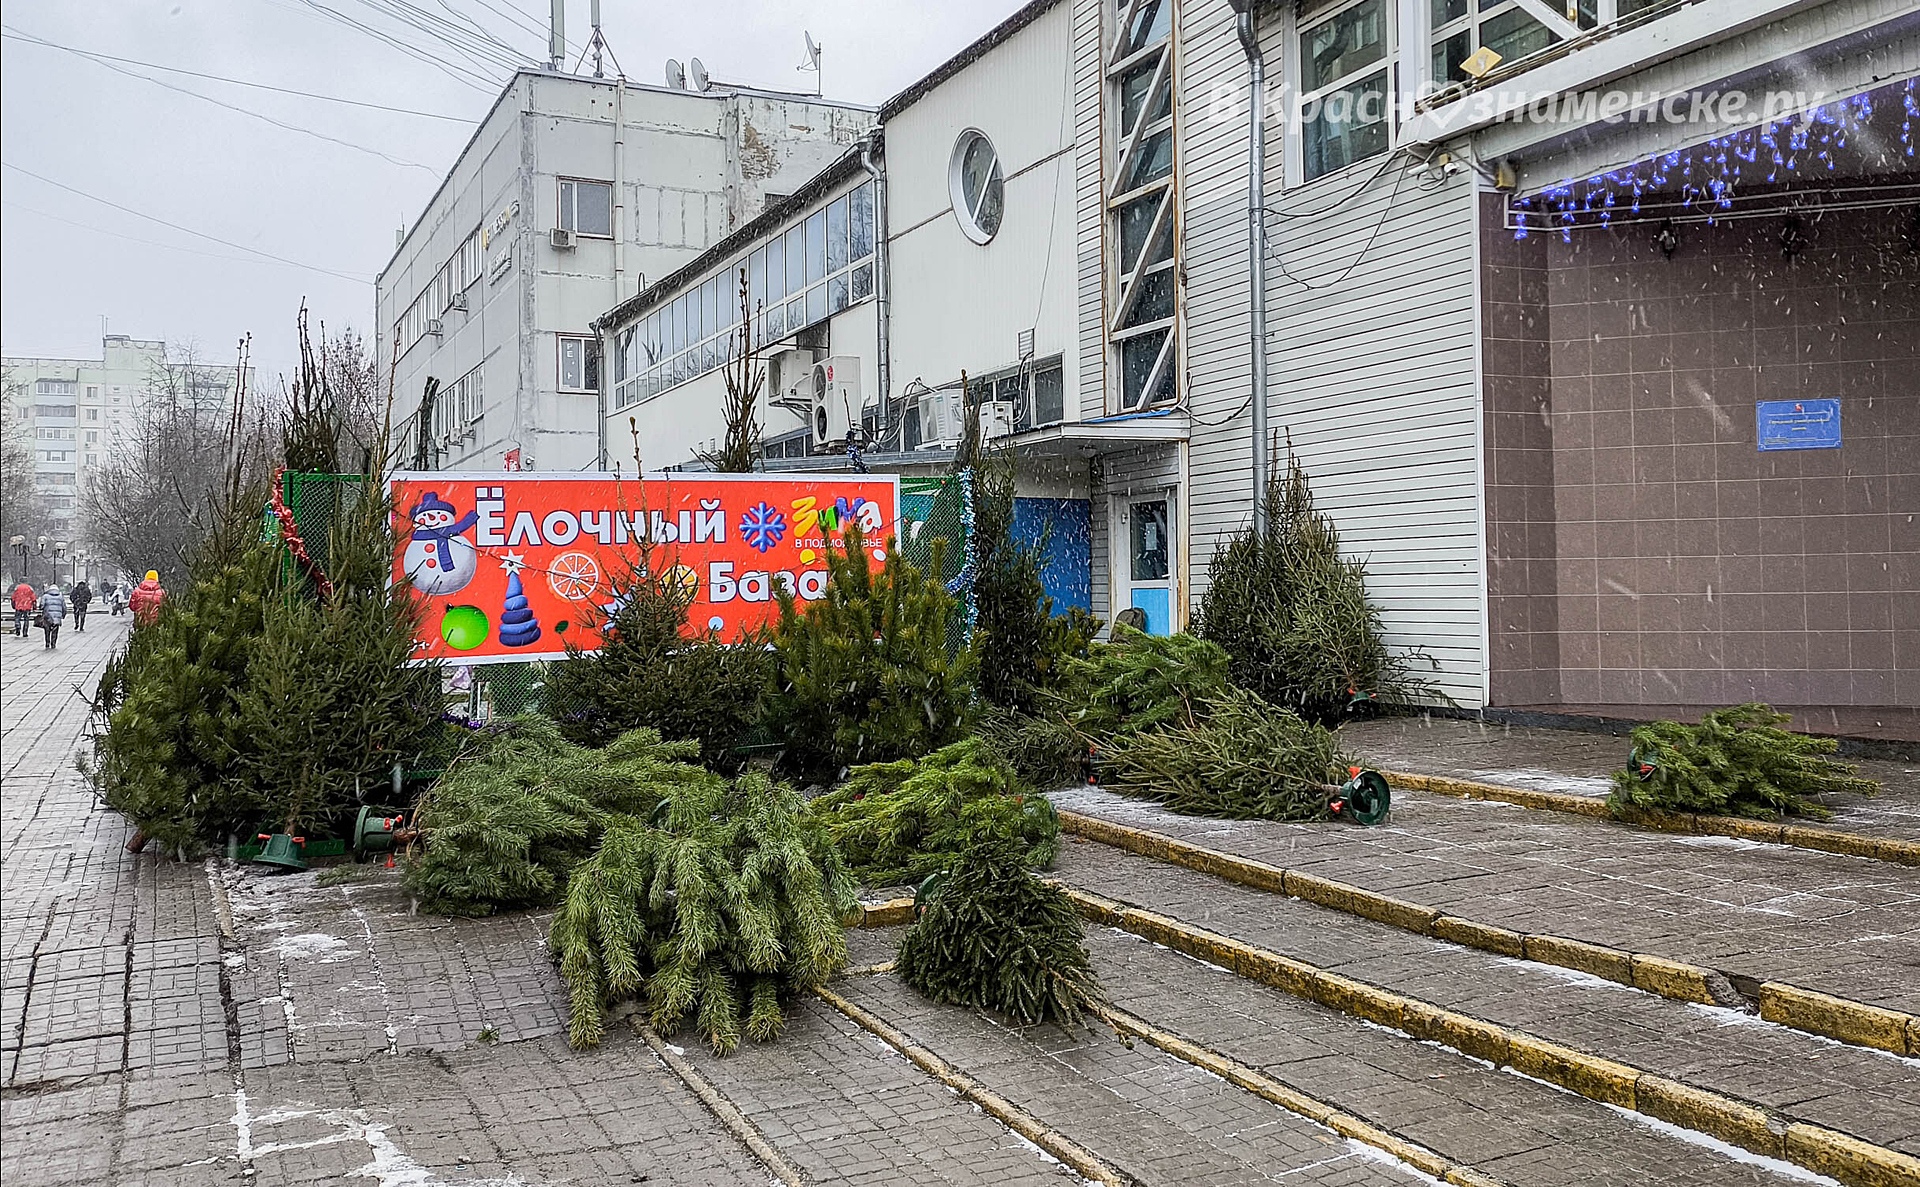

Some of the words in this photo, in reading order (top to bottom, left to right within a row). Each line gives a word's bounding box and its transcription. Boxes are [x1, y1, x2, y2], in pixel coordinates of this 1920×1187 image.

[475, 486, 726, 547] Ёлочный
[795, 538, 802, 548] В
[708, 560, 846, 604] База
